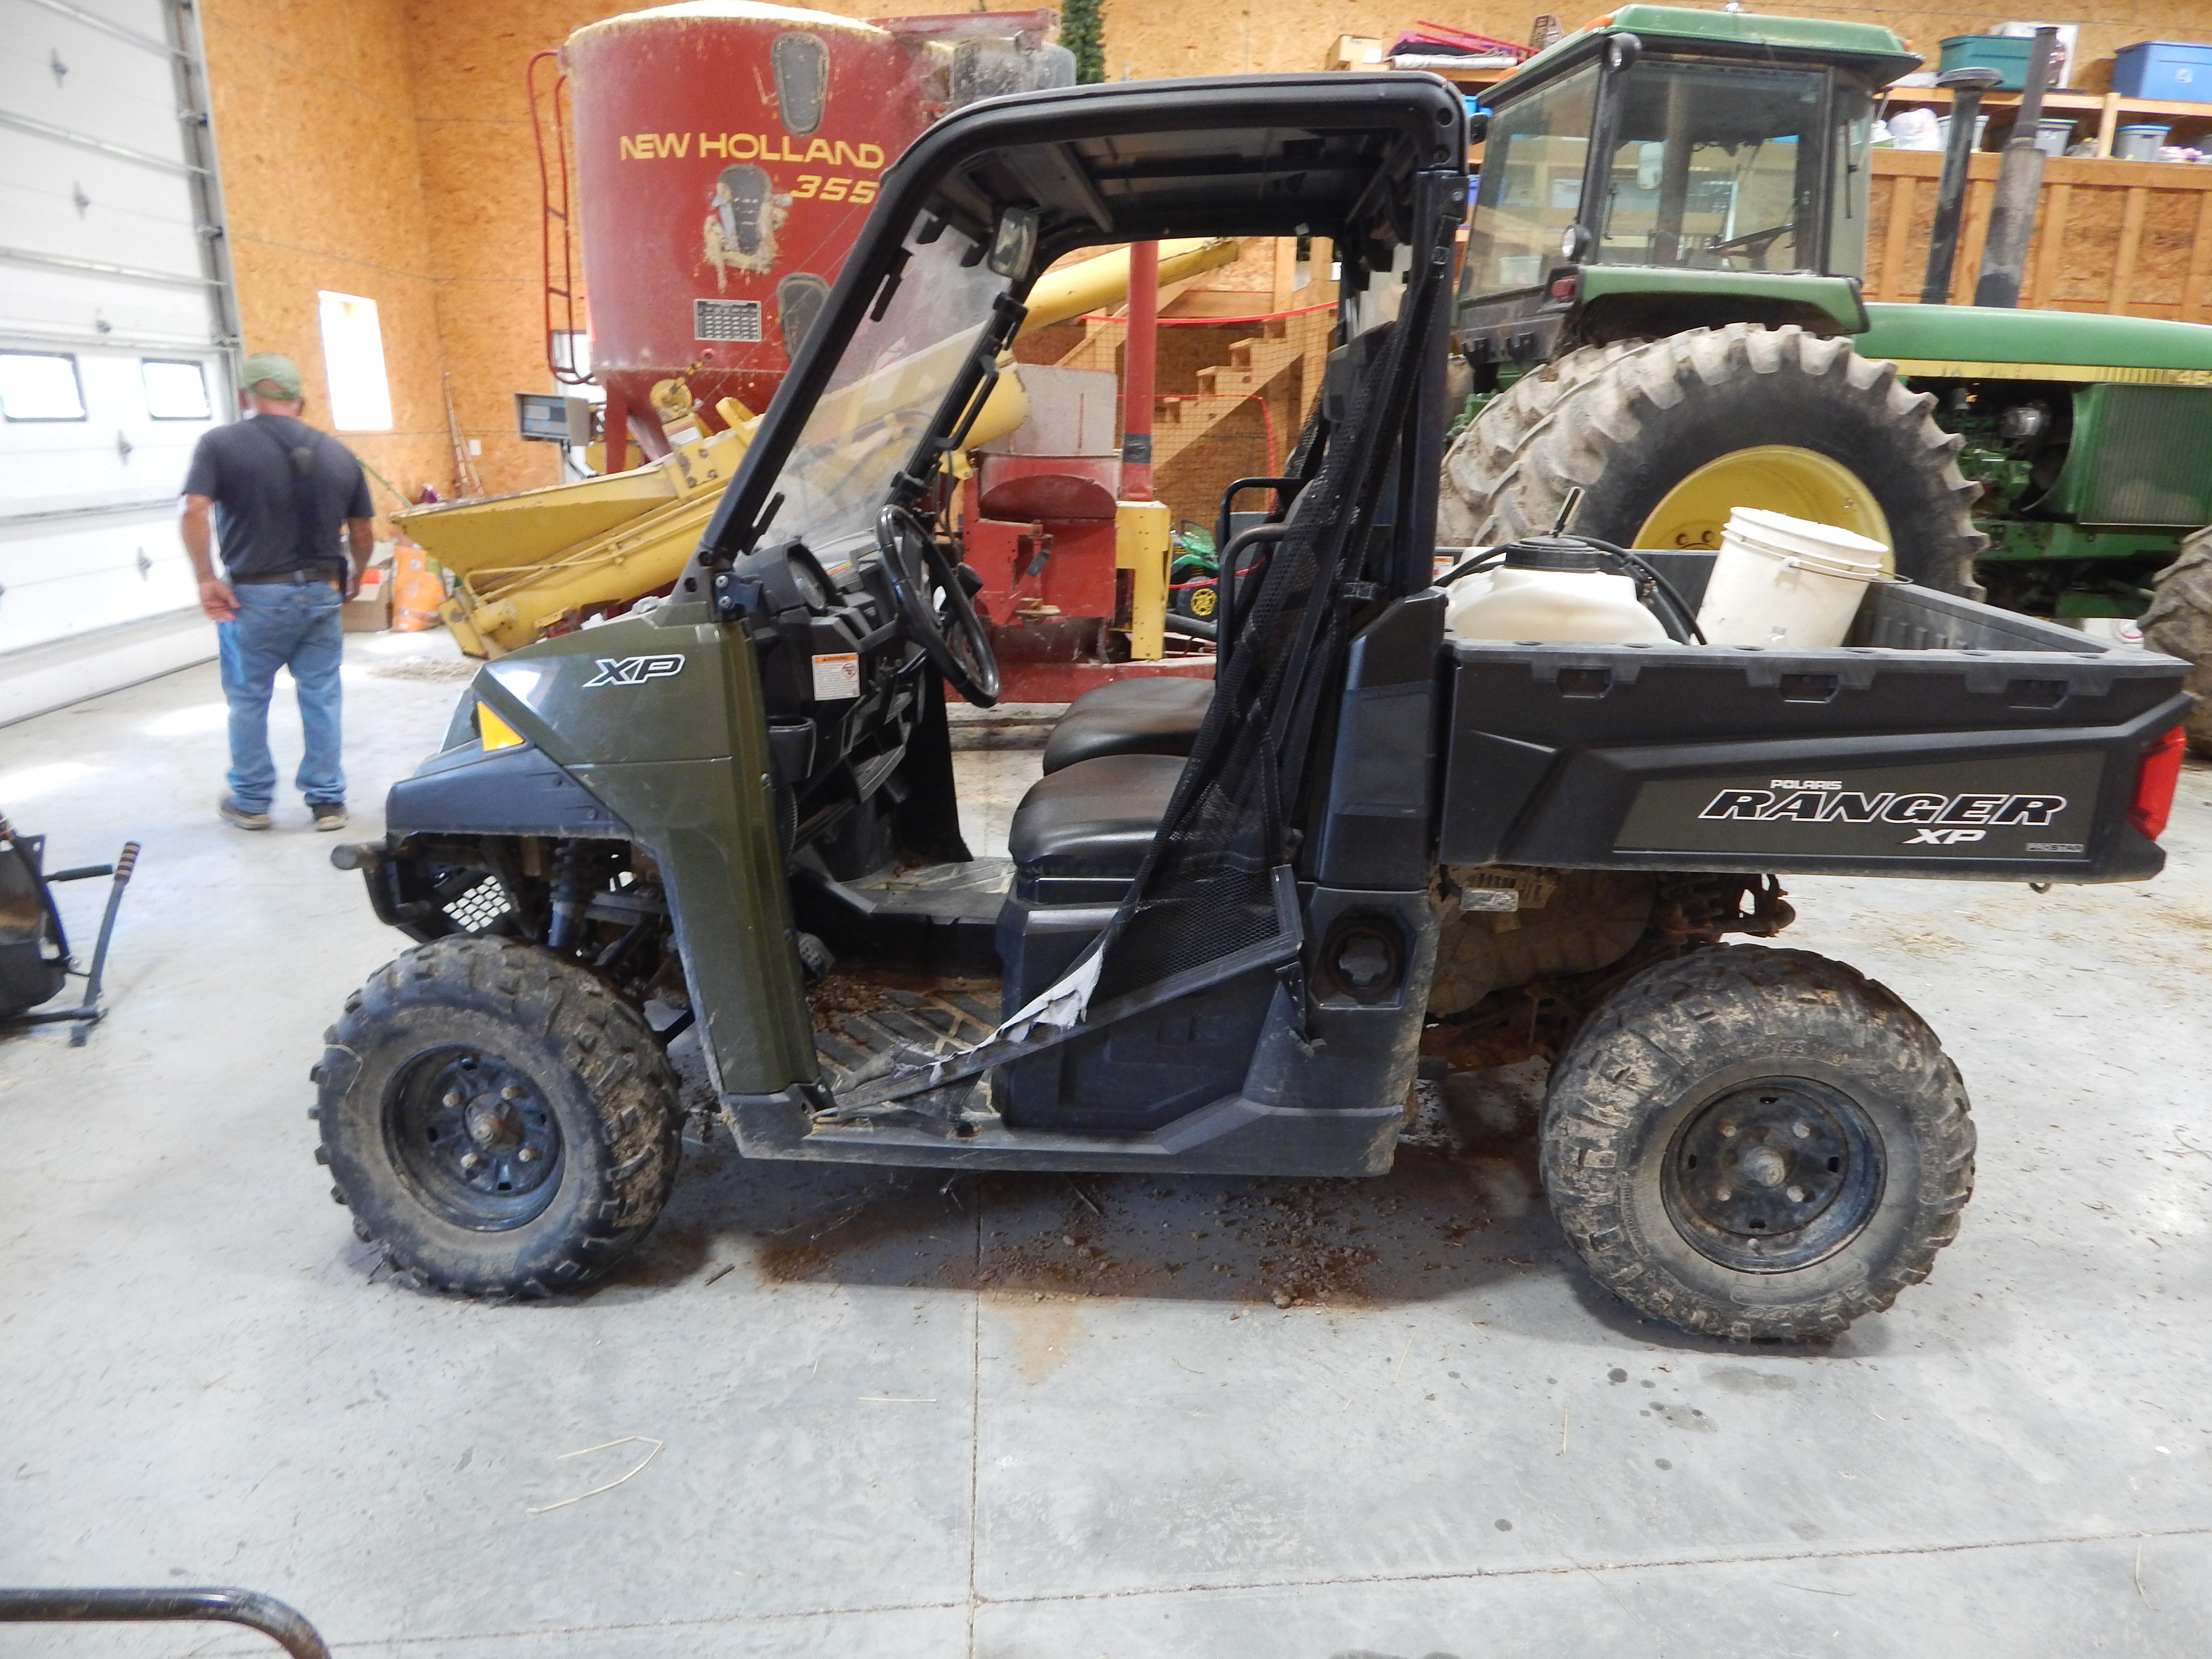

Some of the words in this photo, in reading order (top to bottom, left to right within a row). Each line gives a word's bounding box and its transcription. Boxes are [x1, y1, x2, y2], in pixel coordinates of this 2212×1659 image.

[620, 132, 691, 160] NEW
[699, 132, 885, 169] HOLLAND
[790, 174, 880, 204] 355
[582, 653, 685, 688] XP
[1769, 779, 1842, 790] POLARIS
[1697, 789, 2068, 826] RANGER
[1901, 828, 1987, 844] XP
